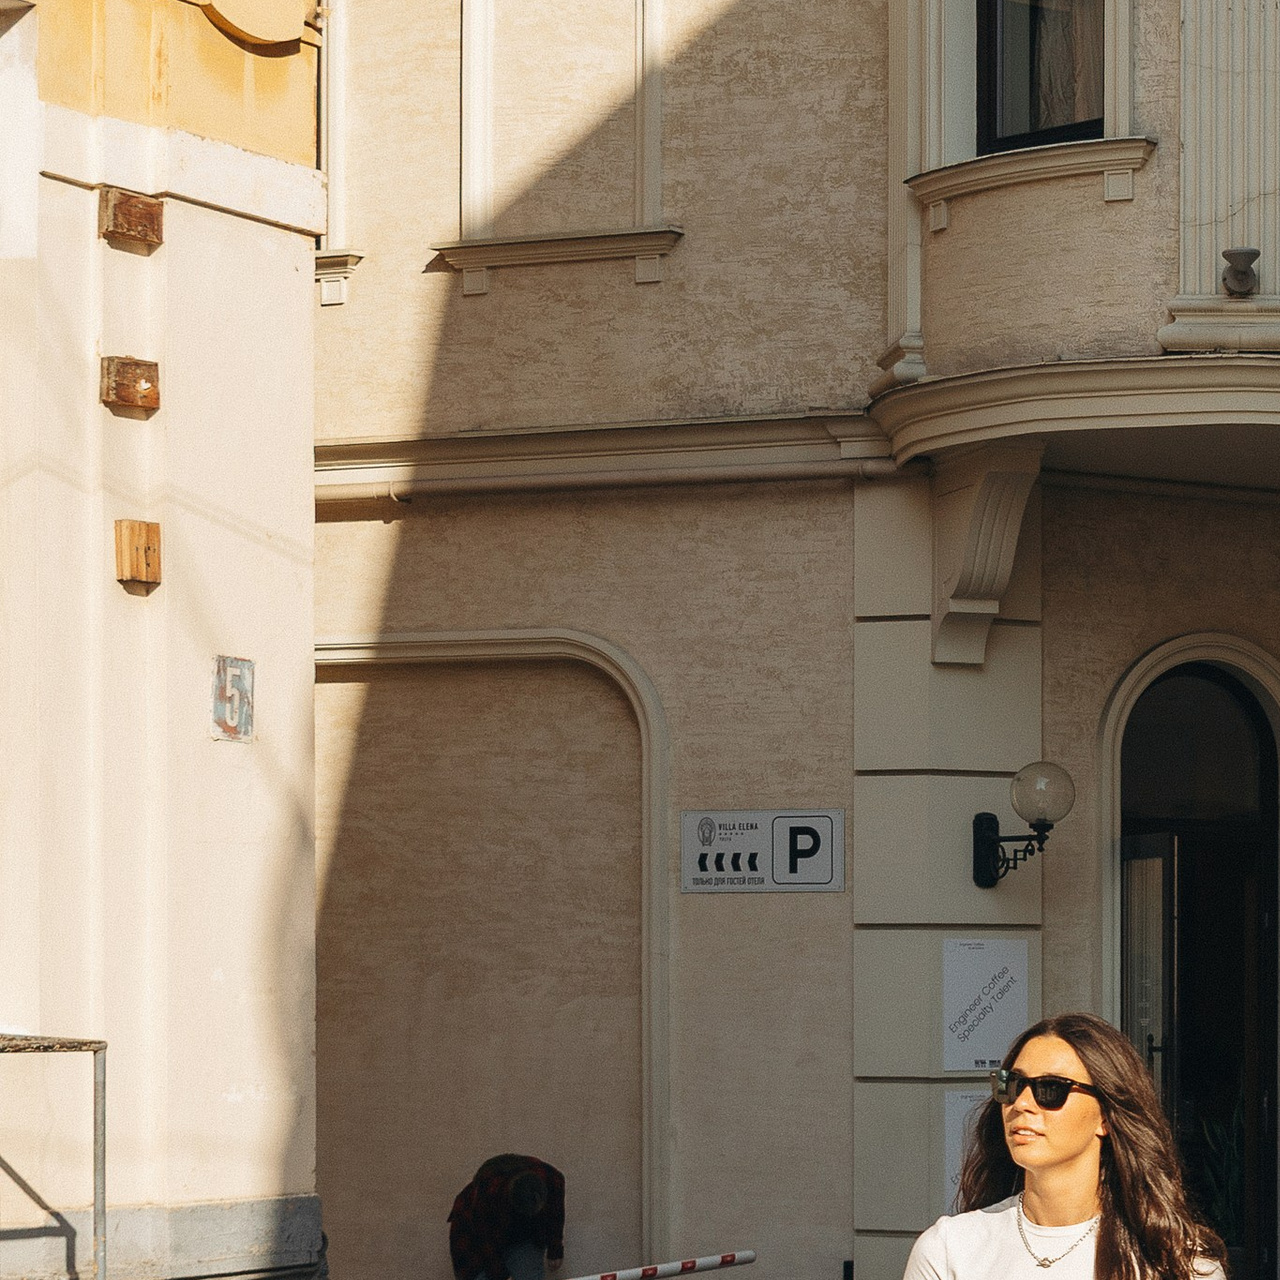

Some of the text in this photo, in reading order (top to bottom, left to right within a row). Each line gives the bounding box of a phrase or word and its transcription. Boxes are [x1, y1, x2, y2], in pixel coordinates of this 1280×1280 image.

[226, 667, 241, 728] 5
[718, 822, 759, 831] VILLA ELENA
[788, 826, 822, 874] P
[692, 877, 713, 886] ТОЛЬКО
[726, 875, 746, 886] ГОСТЕЙ
[747, 877, 765, 886] ОТЕЛЯ
[948, 965, 1010, 1034] Engineer Coffee
[957, 1004, 996, 1043] Specialty
[992, 975, 1018, 1004] Talent
